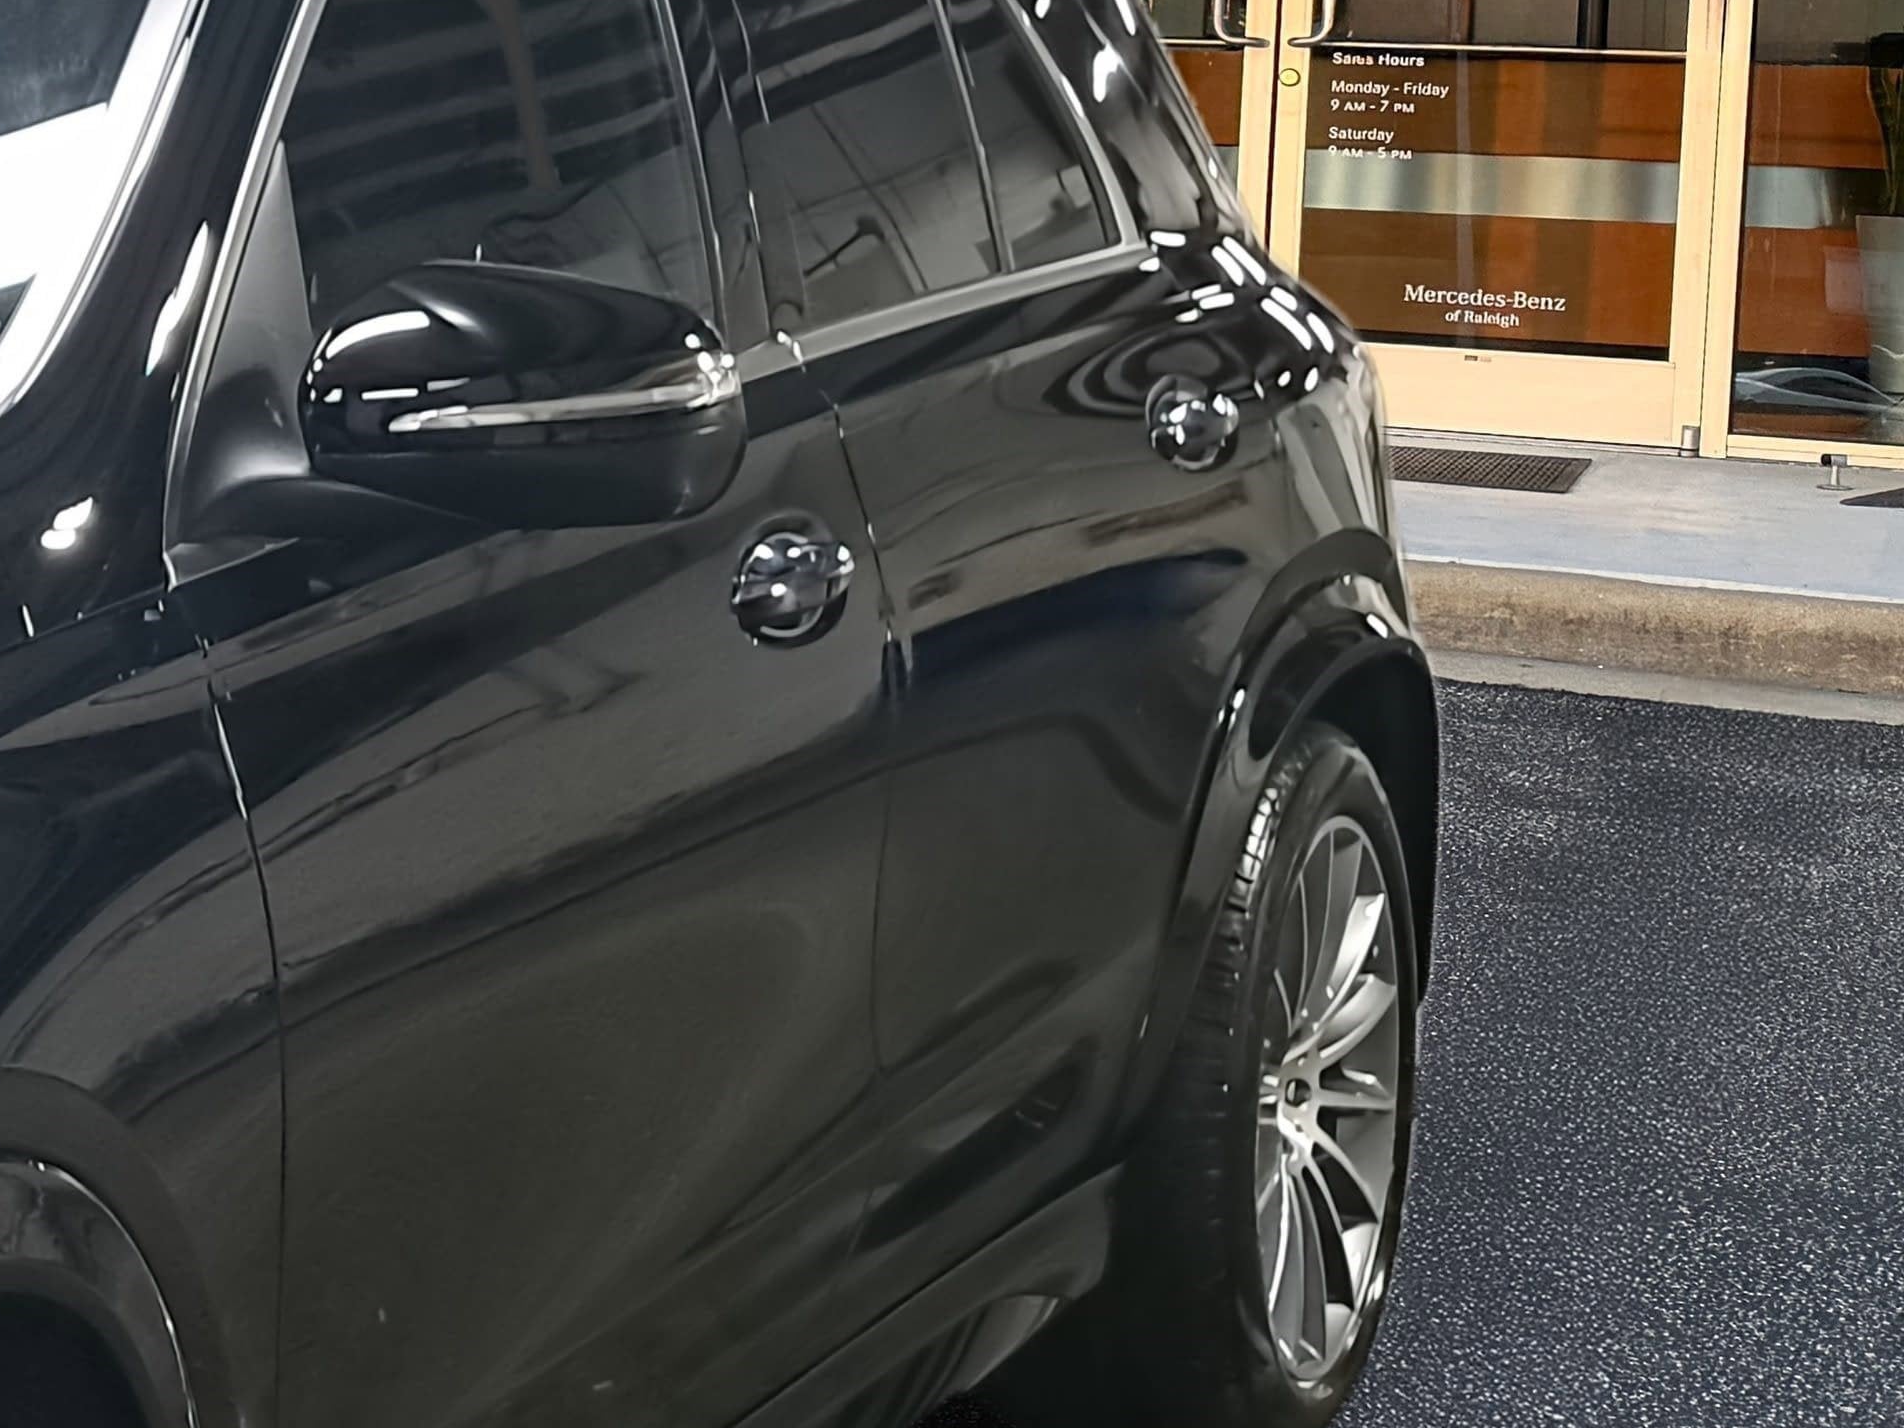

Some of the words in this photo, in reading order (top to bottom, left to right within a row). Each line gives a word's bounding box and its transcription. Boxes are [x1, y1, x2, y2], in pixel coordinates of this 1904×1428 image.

[1378, 53, 1425, 67] Hours
[1331, 80, 1390, 97] Monday
[1403, 82, 1450, 98] Friday
[1330, 98, 1340, 111] 9
[1343, 101, 1366, 111] AM
[1379, 100, 1390, 112] 7
[1393, 103, 1415, 113] PM
[1328, 126, 1394, 144] Saturday
[1328, 145, 1337, 157] 9
[1342, 148, 1364, 158] AM
[1377, 146, 1386, 158] 5
[1391, 150, 1413, 159] PM
[1403, 284, 1566, 312] Mercedes-Benz
[1444, 309, 1462, 322] of
